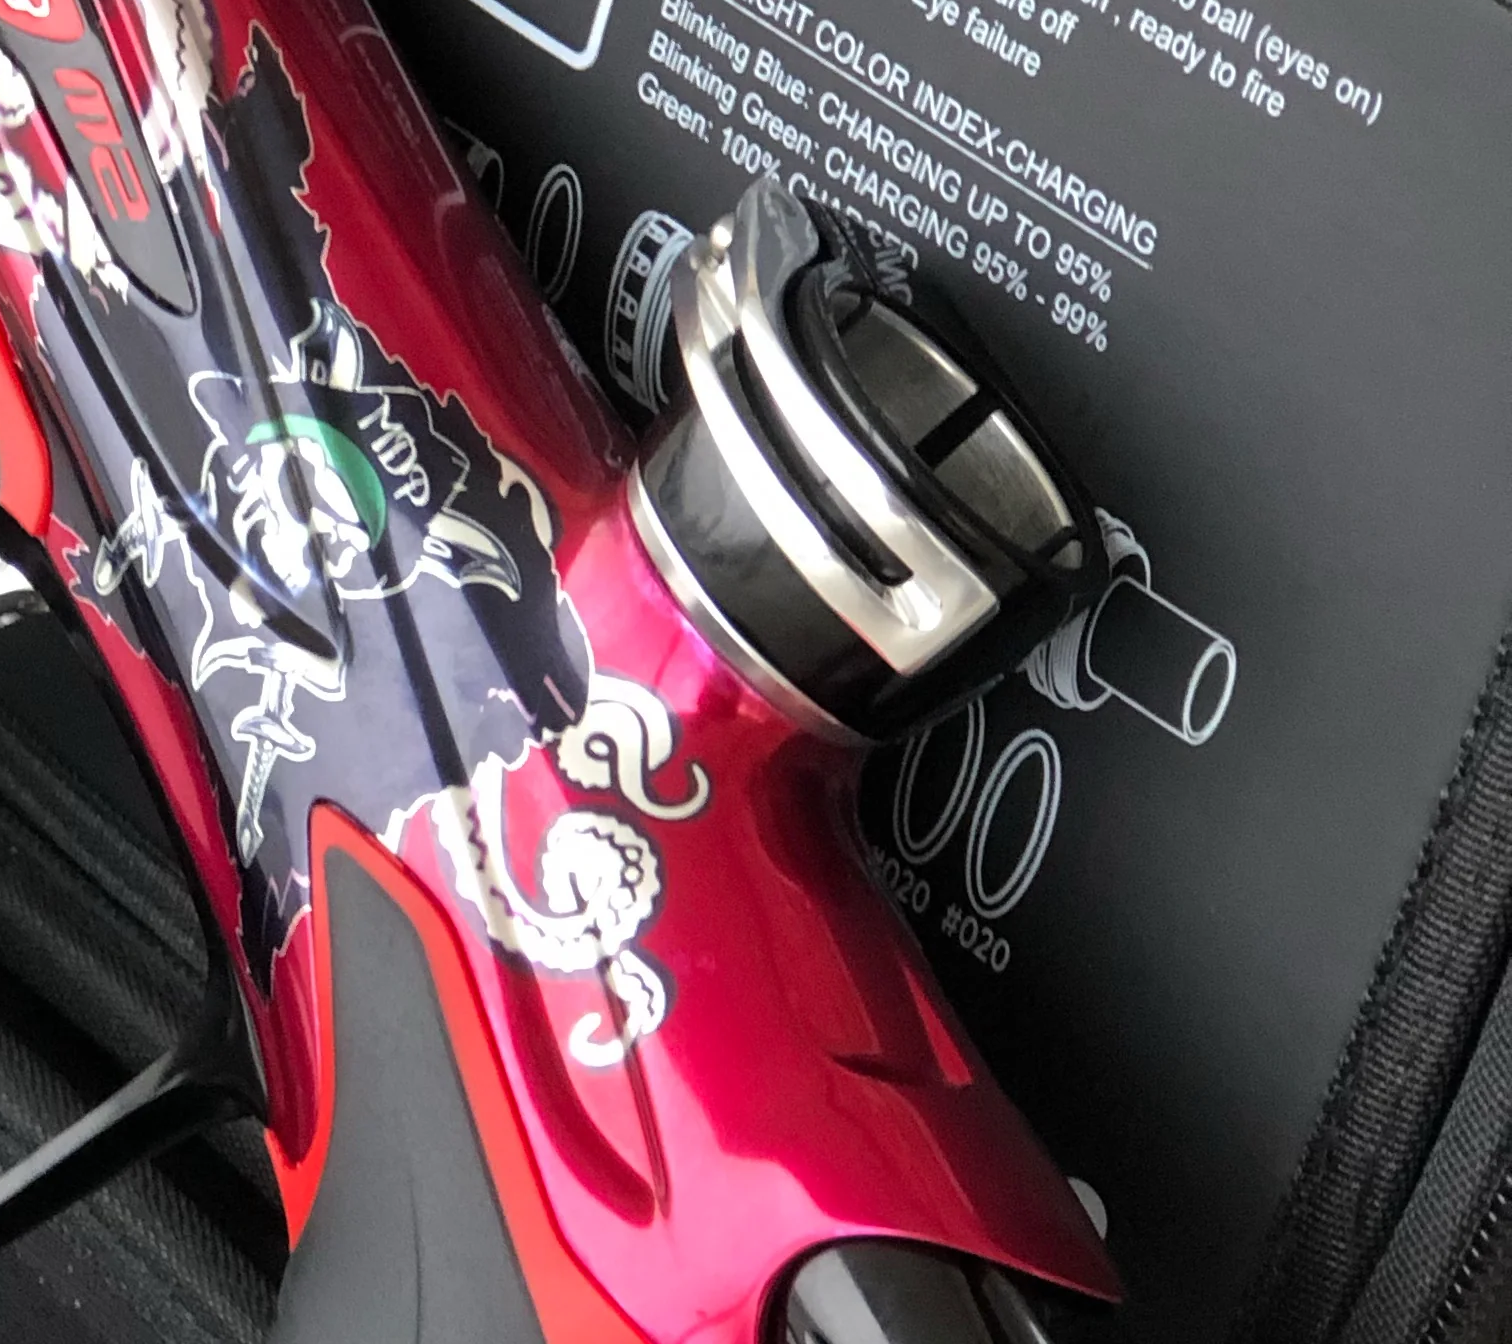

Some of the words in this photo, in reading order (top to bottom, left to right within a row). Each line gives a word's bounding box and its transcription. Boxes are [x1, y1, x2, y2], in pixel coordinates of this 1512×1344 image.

[962, 5, 1042, 78] failure
[1038, 4, 1080, 45] off
[1129, 5, 1207, 75] ready
[1209, 46, 1238, 89] to
[1240, 69, 1288, 119] fire
[1254, 21, 1328, 92] (eyes
[1333, 75, 1384, 126] on)
[637, 70, 714, 145] Green:
[814, 17, 912, 102] COLOR
[912, 78, 1159, 256] INDEX-CHARGING
[648, 29, 738, 116] Blinking
[741, 90, 821, 165] Green:
[824, 145, 970, 261] CHARGING
[972, 242, 1029, 304] 95%
[1049, 292, 1110, 354] 99%
[752, 46, 814, 110] Blue:
[817, 90, 966, 206] CHARGING
[966, 184, 1010, 231] UP
[1014, 211, 1053, 262] TO
[1056, 244, 1115, 305] 95%
[941, 903, 1011, 973] #020
